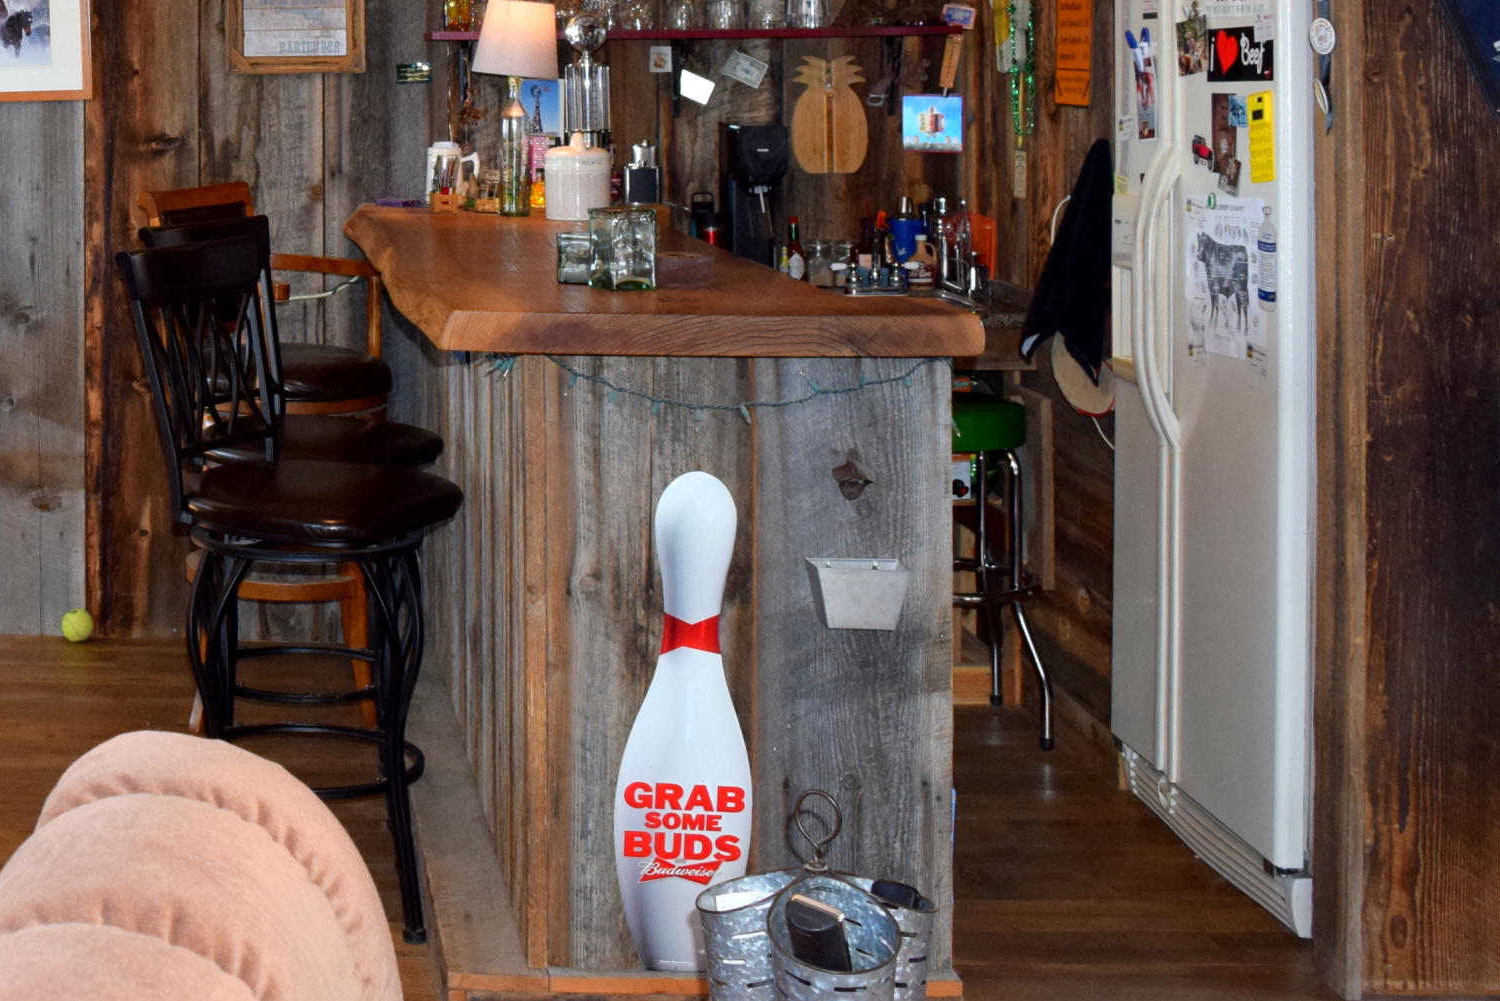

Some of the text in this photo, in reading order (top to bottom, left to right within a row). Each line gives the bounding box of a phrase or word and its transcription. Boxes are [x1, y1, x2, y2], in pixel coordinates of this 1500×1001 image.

[1240, 32, 1266, 74] Beef
[624, 781, 745, 813] GRAB
[644, 811, 722, 832] SOME
[623, 830, 741, 862] BUDS
